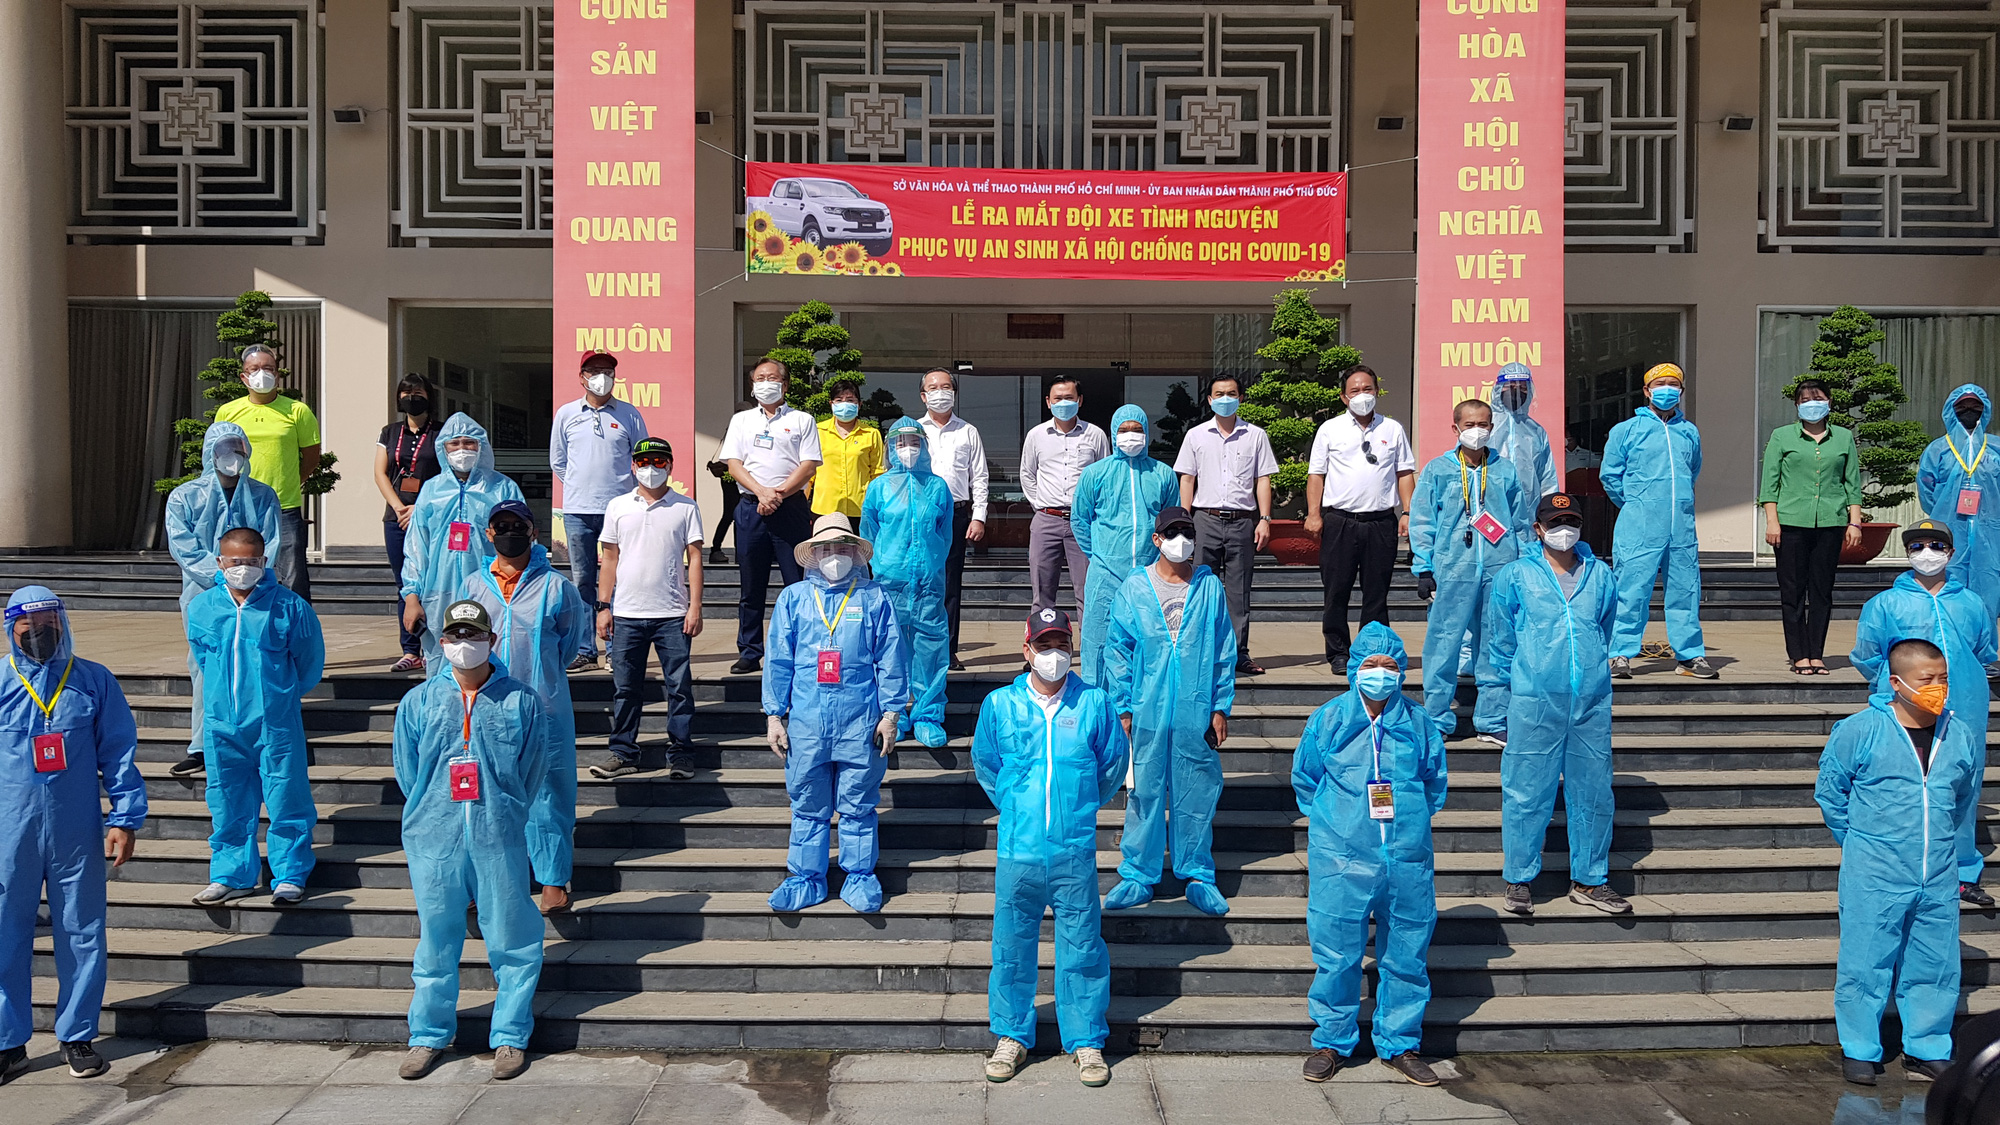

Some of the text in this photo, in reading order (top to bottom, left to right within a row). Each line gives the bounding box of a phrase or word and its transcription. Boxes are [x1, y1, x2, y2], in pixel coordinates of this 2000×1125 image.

[1459, 27, 1526, 58] HÒA
[591, 42, 656, 75] SẢN
[1470, 73, 1514, 102] XÃ
[590, 101, 657, 136] VIỆT
[1464, 117, 1518, 152] HỘI
[587, 162, 660, 186] NAM
[893, 178, 907, 191] SỞ
[909, 180, 930, 192] VĂN
[933, 180, 954, 192] HÓA
[957, 180, 971, 192] VÀ
[973, 178, 990, 193] THỂ
[992, 184, 1018, 193] THAO
[1020, 181, 1052, 194] THÀNH
[1055, 180, 1076, 194] PHỐ
[1078, 180, 1092, 195] HỒ
[1095, 182, 1114, 195] CHÍ
[1116, 186, 1140, 195] MINH
[1149, 183, 1161, 196] ỦY
[1163, 187, 1182, 196] BAN
[1186, 185, 1213, 196] NHÂN
[1216, 185, 1236, 196] DÂN
[1239, 184, 1270, 197] THÀNH
[1273, 183, 1294, 197] PHỐ
[1296, 184, 1314, 197] THỦ
[1316, 185, 1338, 197] ĐỨC
[1458, 157, 1524, 191] CHỦ
[571, 217, 676, 244] QUANG
[952, 199, 1278, 232] LỄ RA MẮT ĐỘI XE TÌNH NGUYỆN
[1440, 205, 1543, 235] NGHĨA
[900, 235, 1331, 266] PHỤC VỤ AN SINH XÃ HỘI CHỐNG DỊCH COVID-19
[1456, 249, 1526, 284] VIỆT
[586, 273, 660, 298] VINH
[1452, 298, 1529, 323] NAM
[576, 323, 671, 353] MUÔN
[1441, 337, 1541, 367] MUÔN
[612, 377, 660, 408] ĂM
[1452, 380, 1493, 410] NĂ
